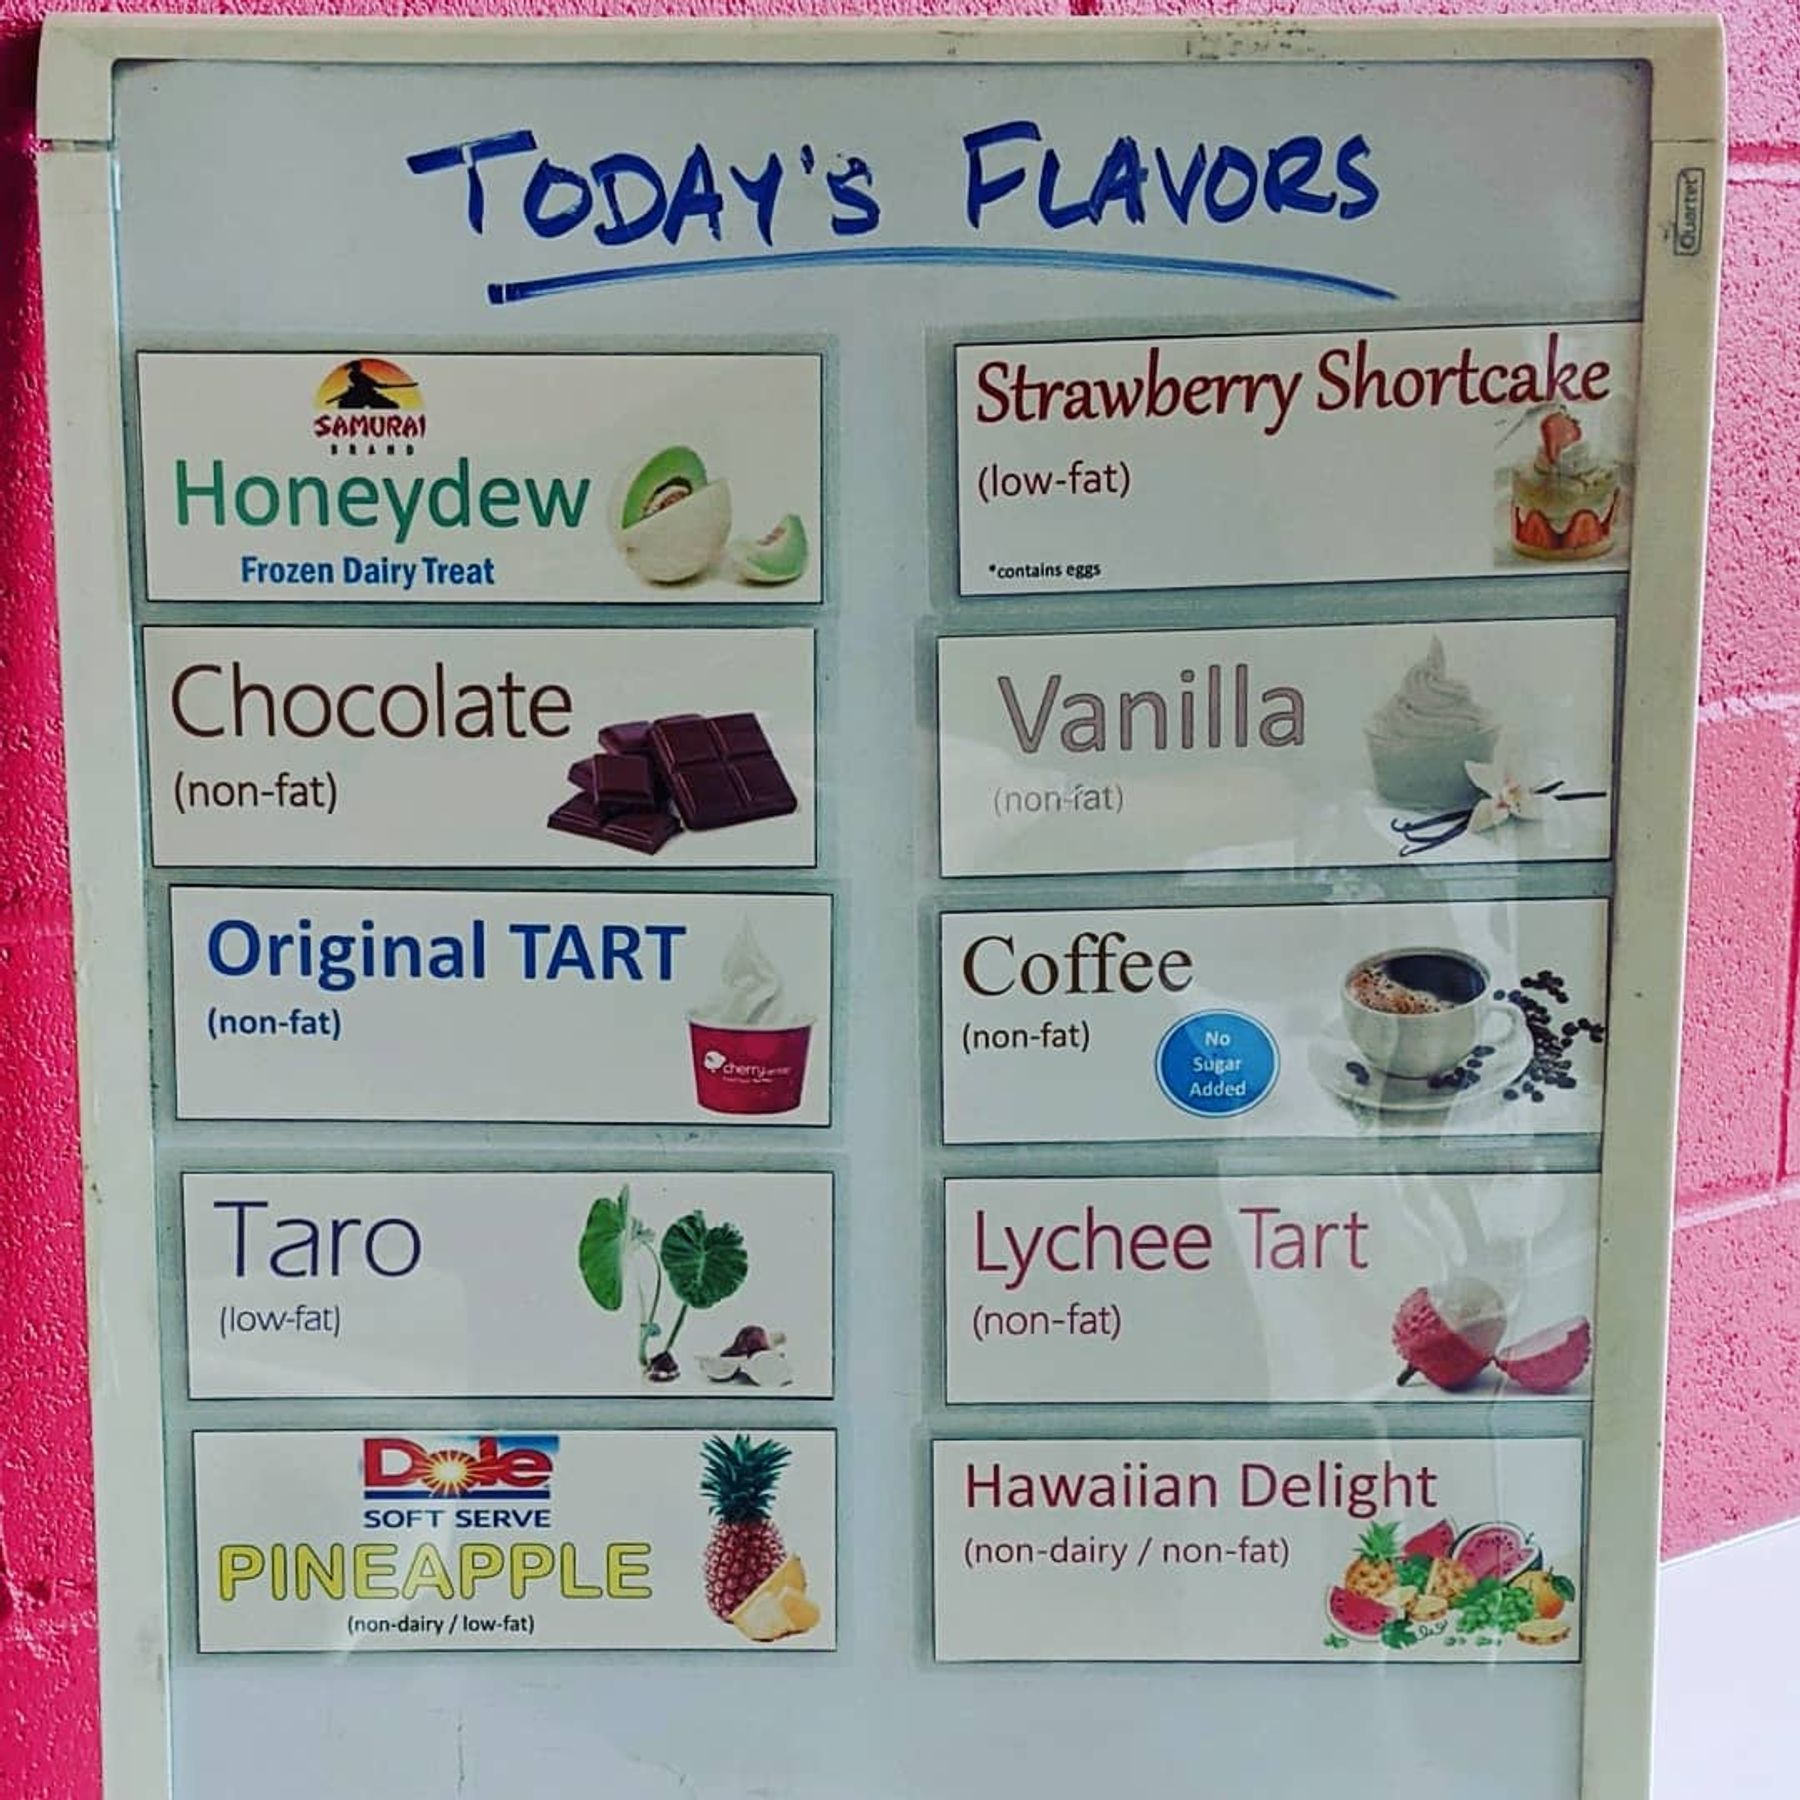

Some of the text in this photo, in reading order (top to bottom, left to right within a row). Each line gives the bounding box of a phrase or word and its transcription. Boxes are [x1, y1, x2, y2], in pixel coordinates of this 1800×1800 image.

[406, 120, 1380, 246] TODAY'S FLAVORS
[1680, 178, 1697, 249] Quartet
[976, 333, 1610, 435] Strawberry Shortcake
[314, 414, 426, 438] SAMURAI
[331, 444, 414, 455] BRAND
[176, 457, 589, 544] Honeydew
[977, 460, 1131, 503] (low-fat)
[242, 556, 495, 590] Frozen Dairy Treat
[1066, 563, 1101, 580] eggs
[171, 662, 572, 740] Chocolate
[998, 663, 1306, 754] Vanilla
[174, 771, 338, 814] (non-fat)
[993, 784, 1124, 817] (non-fat)
[208, 920, 687, 992] Original TART
[962, 932, 1193, 997] Coffee
[207, 1007, 342, 1041] (non-fat)
[961, 1020, 1090, 1053] (non-fat)
[1204, 1031, 1233, 1047] No
[1192, 1056, 1242, 1076] Sugar
[1189, 1080, 1247, 1097] Added
[213, 1200, 421, 1278] Taro
[974, 1206, 1369, 1290] Lychee Tart
[218, 1304, 341, 1338] (low-fat)
[972, 1304, 1122, 1340] (non-fat)
[364, 1436, 553, 1492] Dole
[965, 1460, 1438, 1519] Hawaiian Delight
[364, 1509, 551, 1529] SOFT SERVE
[218, 1542, 653, 1601] PINEAPPLE
[963, 1535, 1290, 1570] (non-dairy / non-fat)
[347, 1614, 535, 1636] (non-dairy / low-fat)
